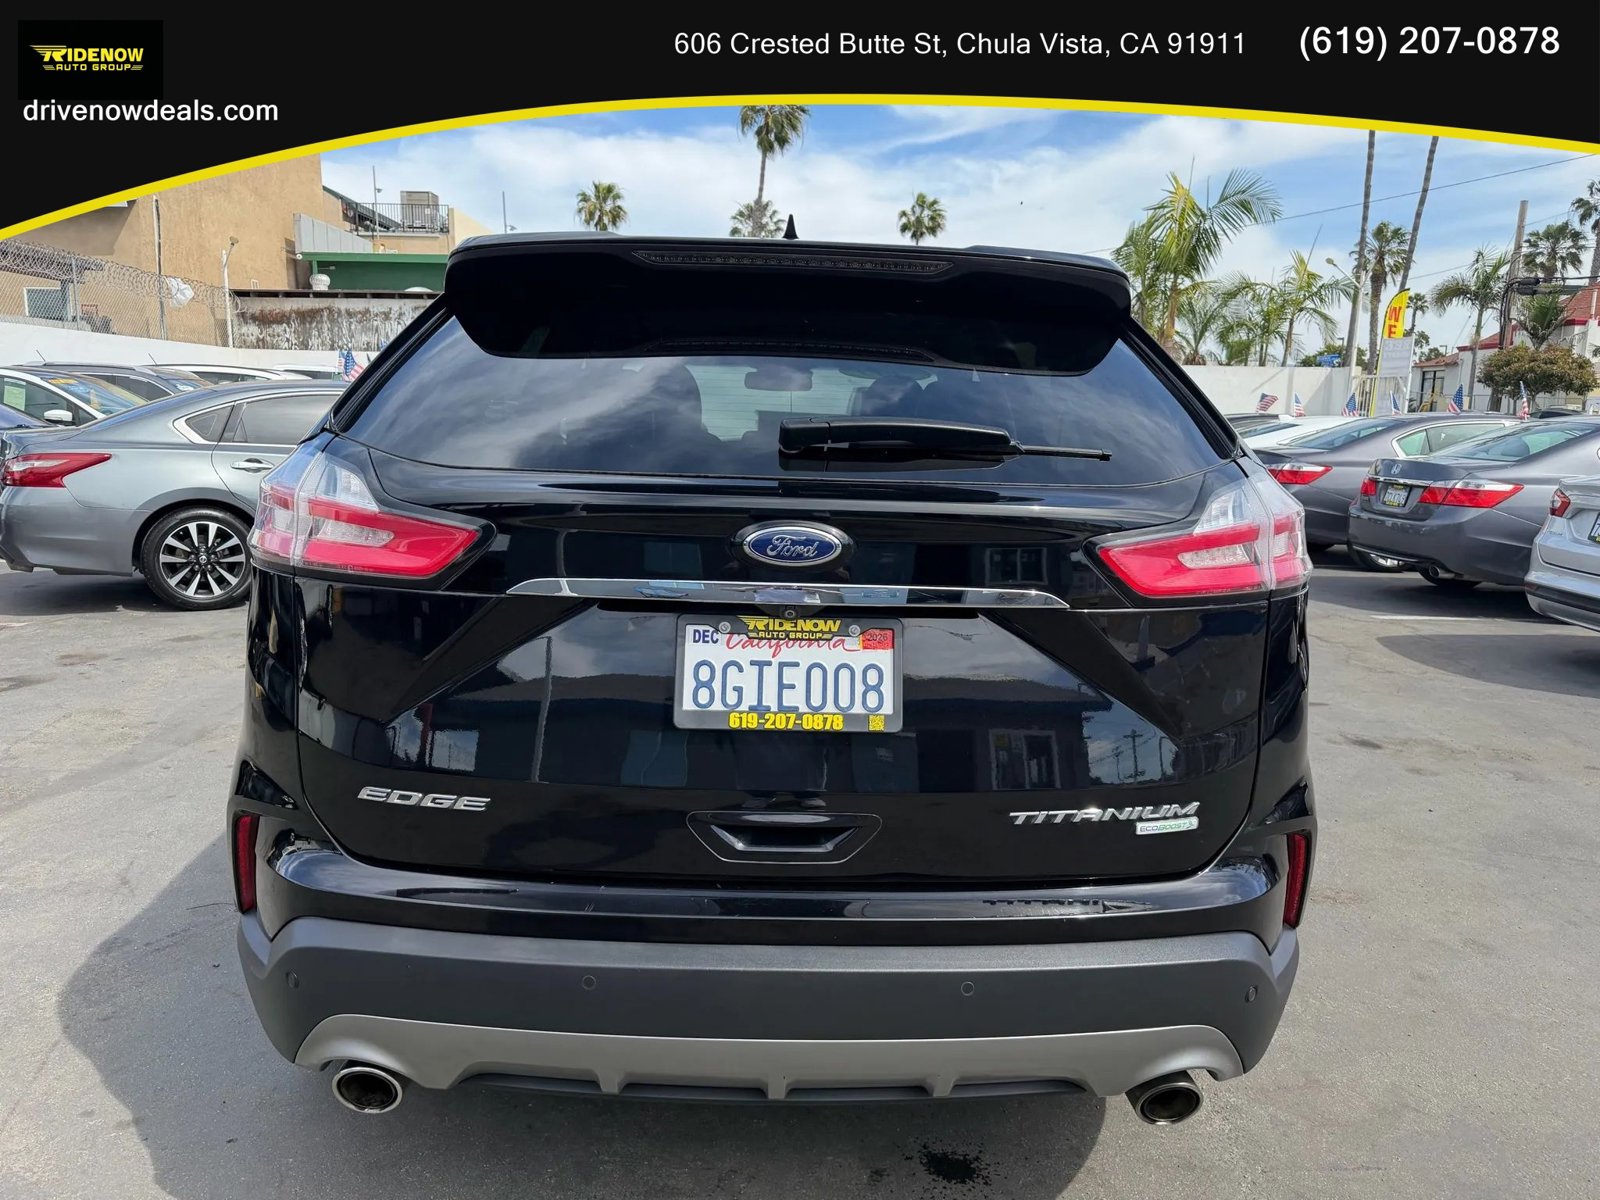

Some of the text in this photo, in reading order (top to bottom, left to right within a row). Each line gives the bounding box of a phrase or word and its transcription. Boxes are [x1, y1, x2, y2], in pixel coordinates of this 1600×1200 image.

[767, 534, 819, 557] Ford
[738, 615, 841, 632] RIDENOW
[692, 629, 719, 644] DEC
[789, 632, 822, 640] GROUP
[692, 659, 884, 712] 8GIE008
[728, 712, 844, 731] 619-207-0878
[357, 786, 491, 812] EDGE
[1009, 801, 1200, 825] TITANIUM
